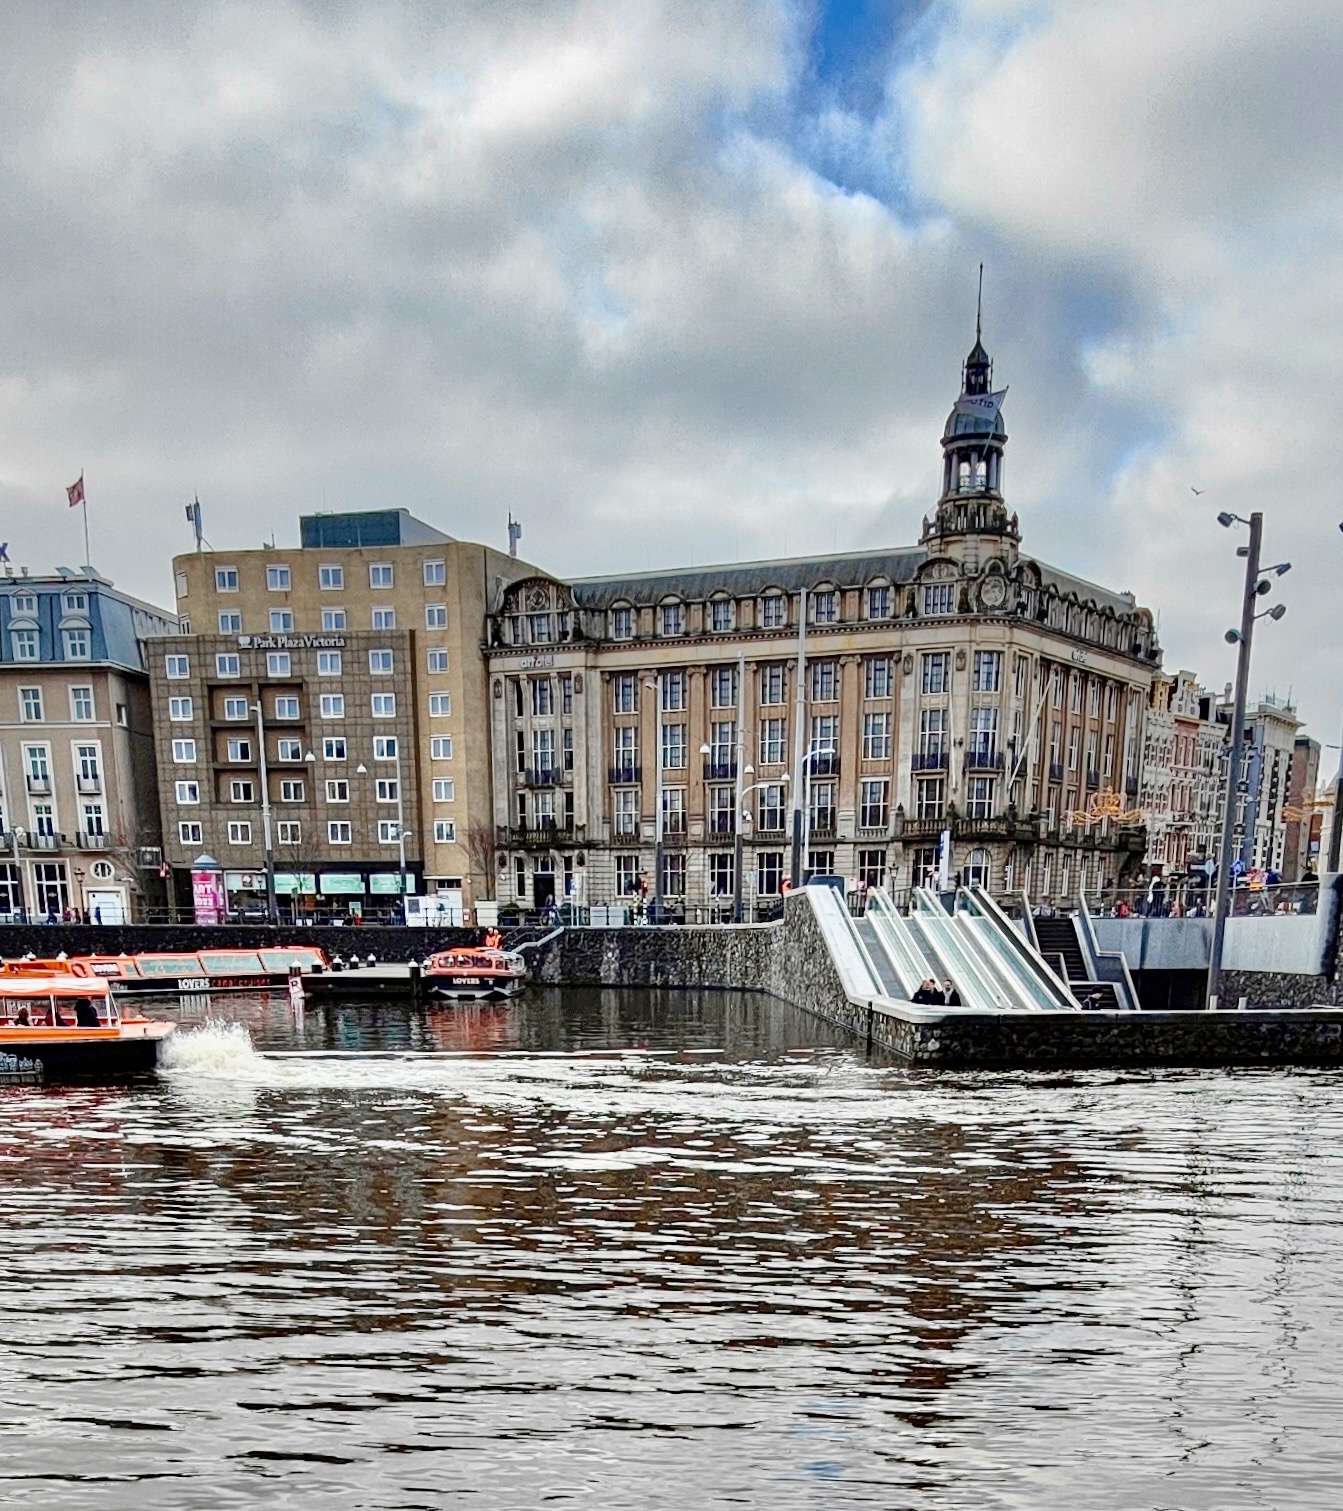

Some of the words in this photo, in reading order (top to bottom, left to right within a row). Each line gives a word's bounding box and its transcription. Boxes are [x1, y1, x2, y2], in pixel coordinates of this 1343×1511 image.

[253, 636, 277, 648] Park
[277, 635, 304, 648] Plaza
[304, 634, 346, 648] Victoria
[178, 978, 210, 989] LOVERS
[211, 978, 236, 988] canal
[238, 977, 271, 987] cruises
